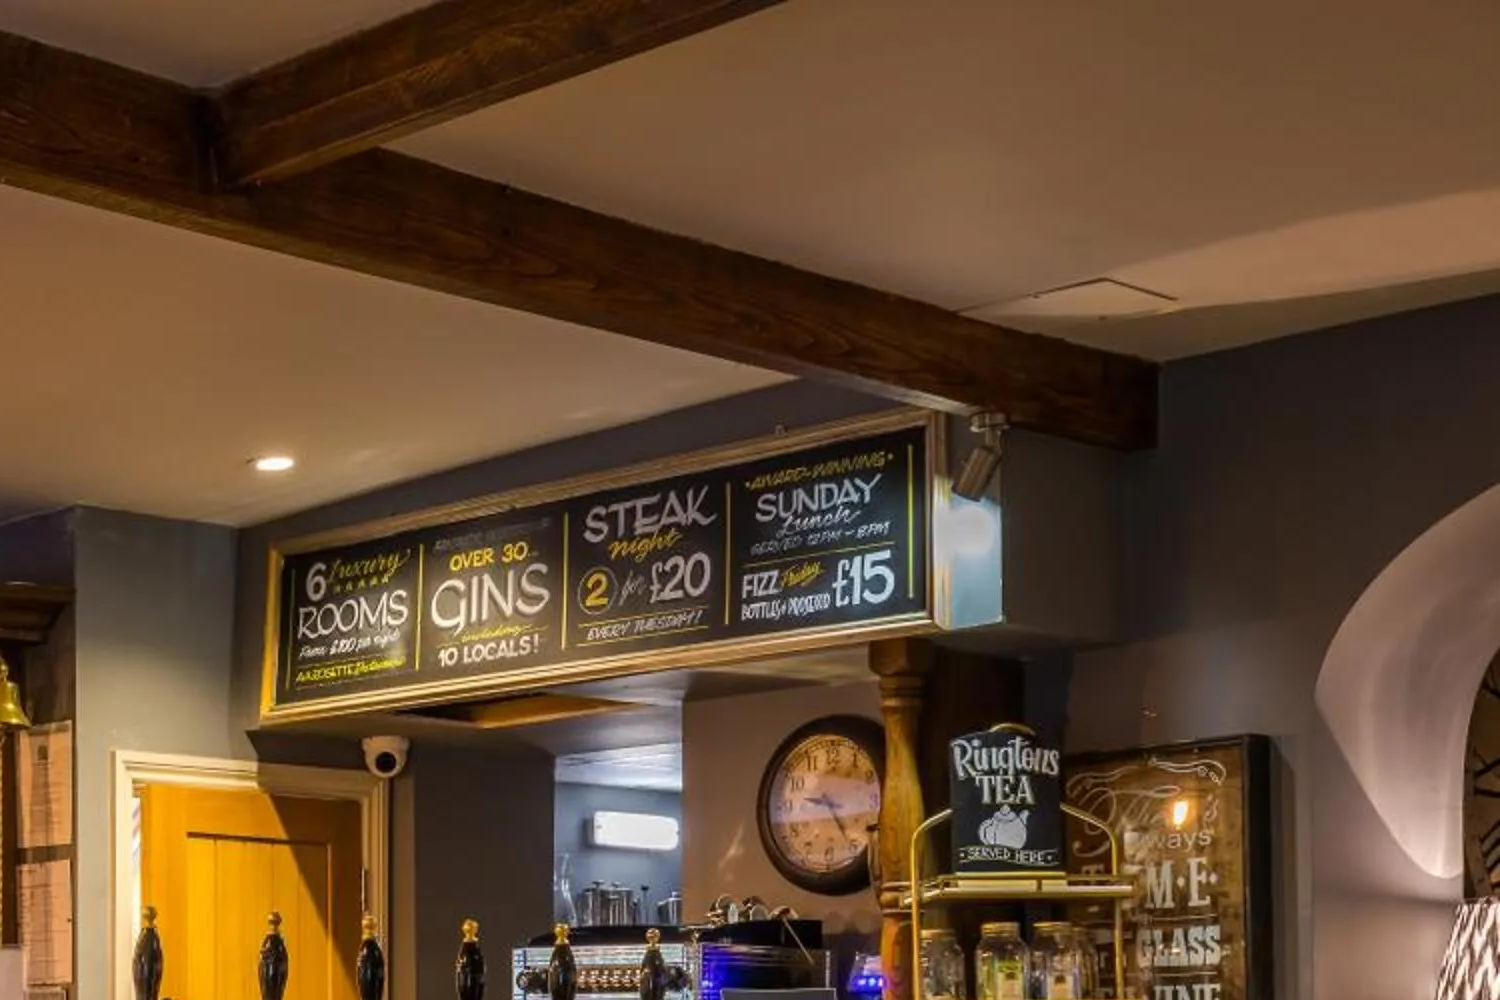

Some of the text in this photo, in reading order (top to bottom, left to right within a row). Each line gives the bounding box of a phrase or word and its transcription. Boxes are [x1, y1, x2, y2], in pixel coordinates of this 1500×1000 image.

[583, 484, 718, 543] STEAK
[755, 473, 882, 522] SUNDAY
[776, 505, 861, 539] Lunch
[450, 547, 494, 571] OVER
[607, 527, 684, 563] night
[305, 562, 327, 601] 6
[585, 572, 609, 607] 2
[650, 552, 711, 603] £20
[742, 570, 780, 598] FIZZ
[832, 549, 896, 608] £15
[298, 589, 409, 639] ROOMS
[431, 563, 549, 637] GINS
[587, 622, 630, 641] EVERY
[438, 634, 539, 667] 10 LOCALS!
[951, 736, 1060, 780] Ringtons
[975, 775, 1035, 804] TEA
[967, 847, 1045, 865] SERVED HERE
